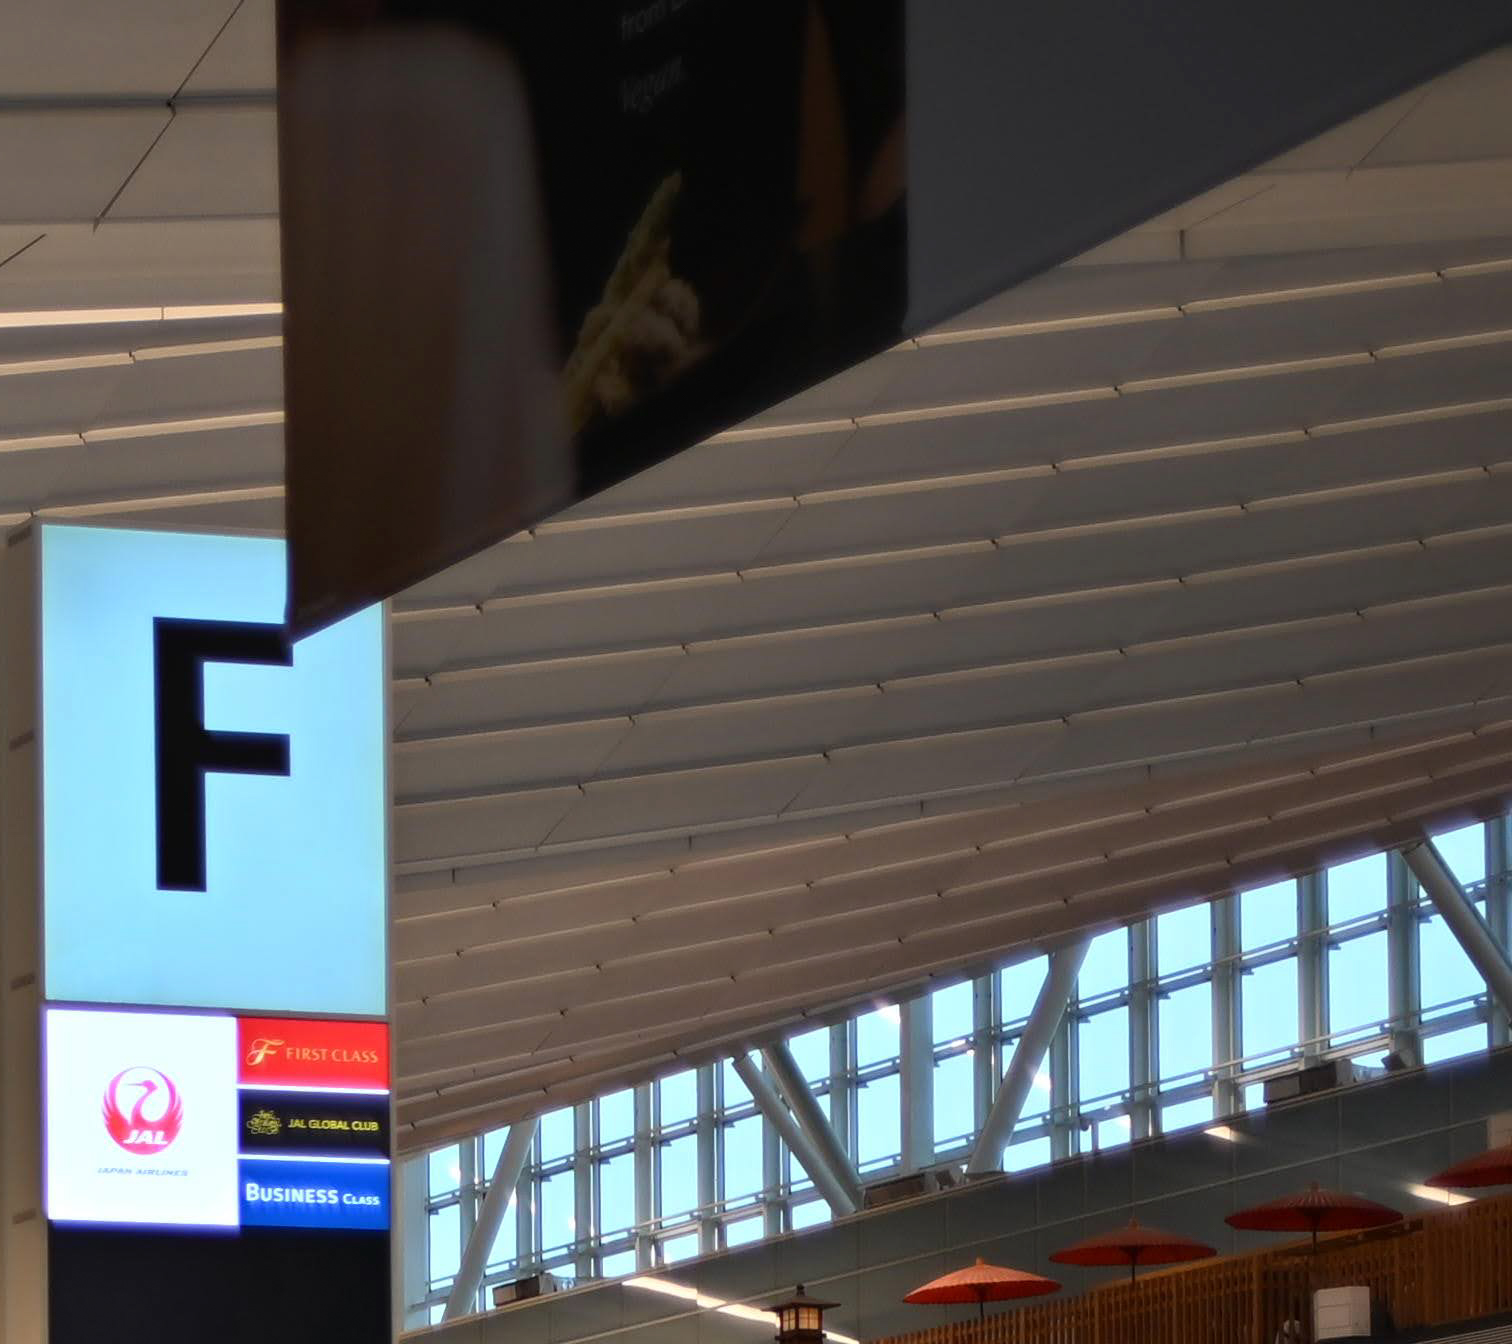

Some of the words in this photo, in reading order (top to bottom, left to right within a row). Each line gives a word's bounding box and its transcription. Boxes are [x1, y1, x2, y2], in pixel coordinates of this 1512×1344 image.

[152, 616, 294, 892] F
[286, 1047, 328, 1062] FIRST
[331, 1048, 379, 1064] CLASS
[308, 1119, 350, 1131] GLOBAL
[351, 1120, 380, 1132] CLUB
[123, 1130, 169, 1145] JAL
[245, 1182, 339, 1205] BUSINESS
[342, 1193, 381, 1206] CLASS
